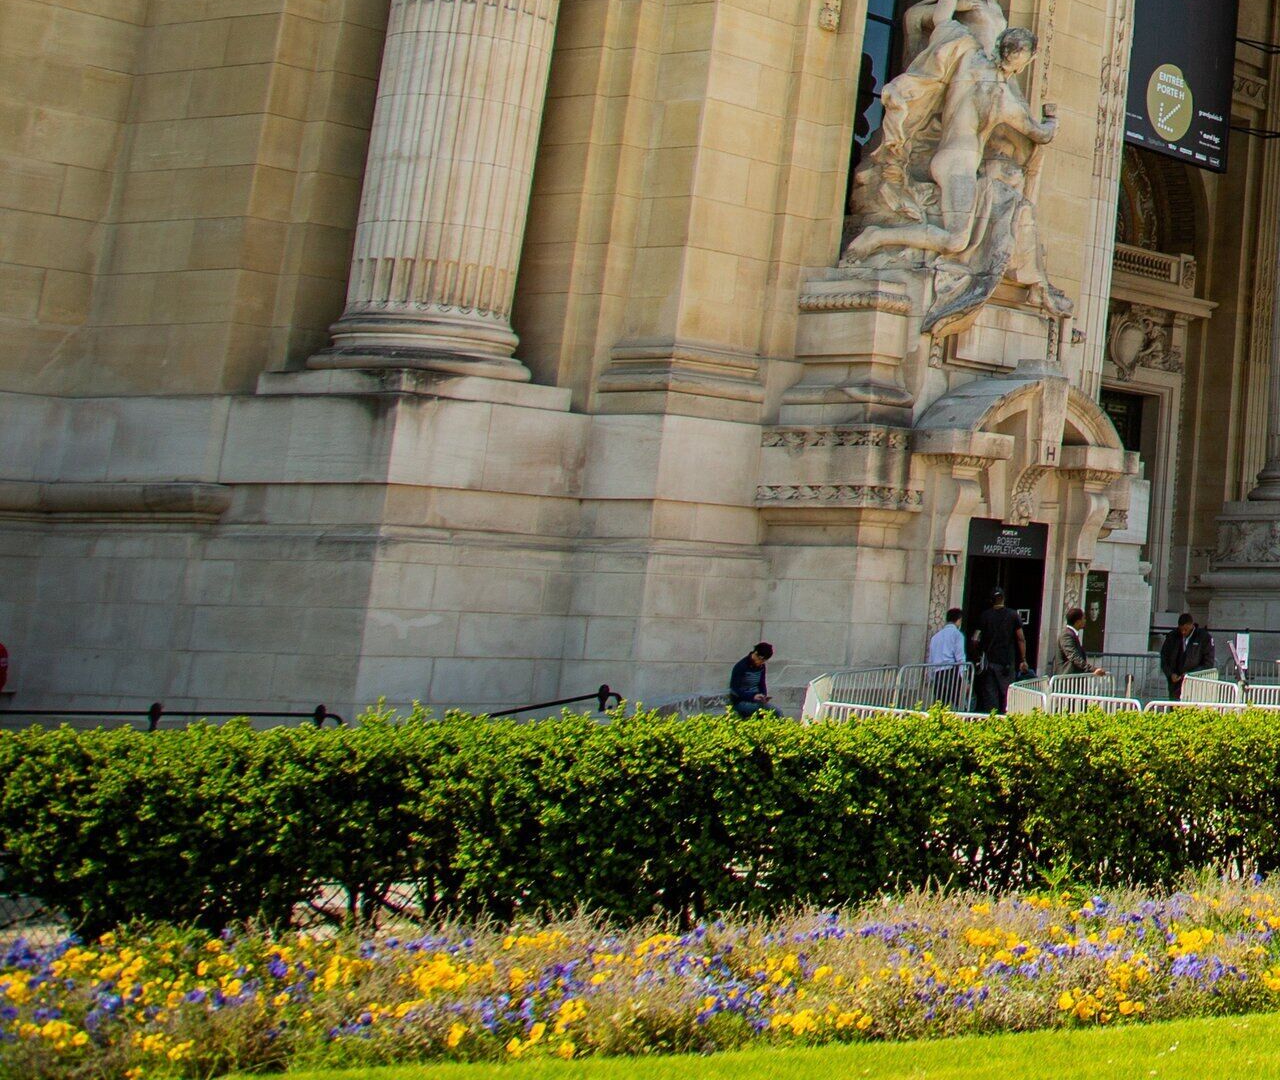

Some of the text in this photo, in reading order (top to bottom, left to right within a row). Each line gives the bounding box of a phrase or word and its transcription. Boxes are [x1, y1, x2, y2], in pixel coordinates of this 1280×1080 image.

[1157, 83, 1178, 98] PORTE
[1047, 446, 1056, 461] H
[996, 537, 1022, 547] ROBERT
[983, 544, 1033, 557] MAPPLETHORPE
